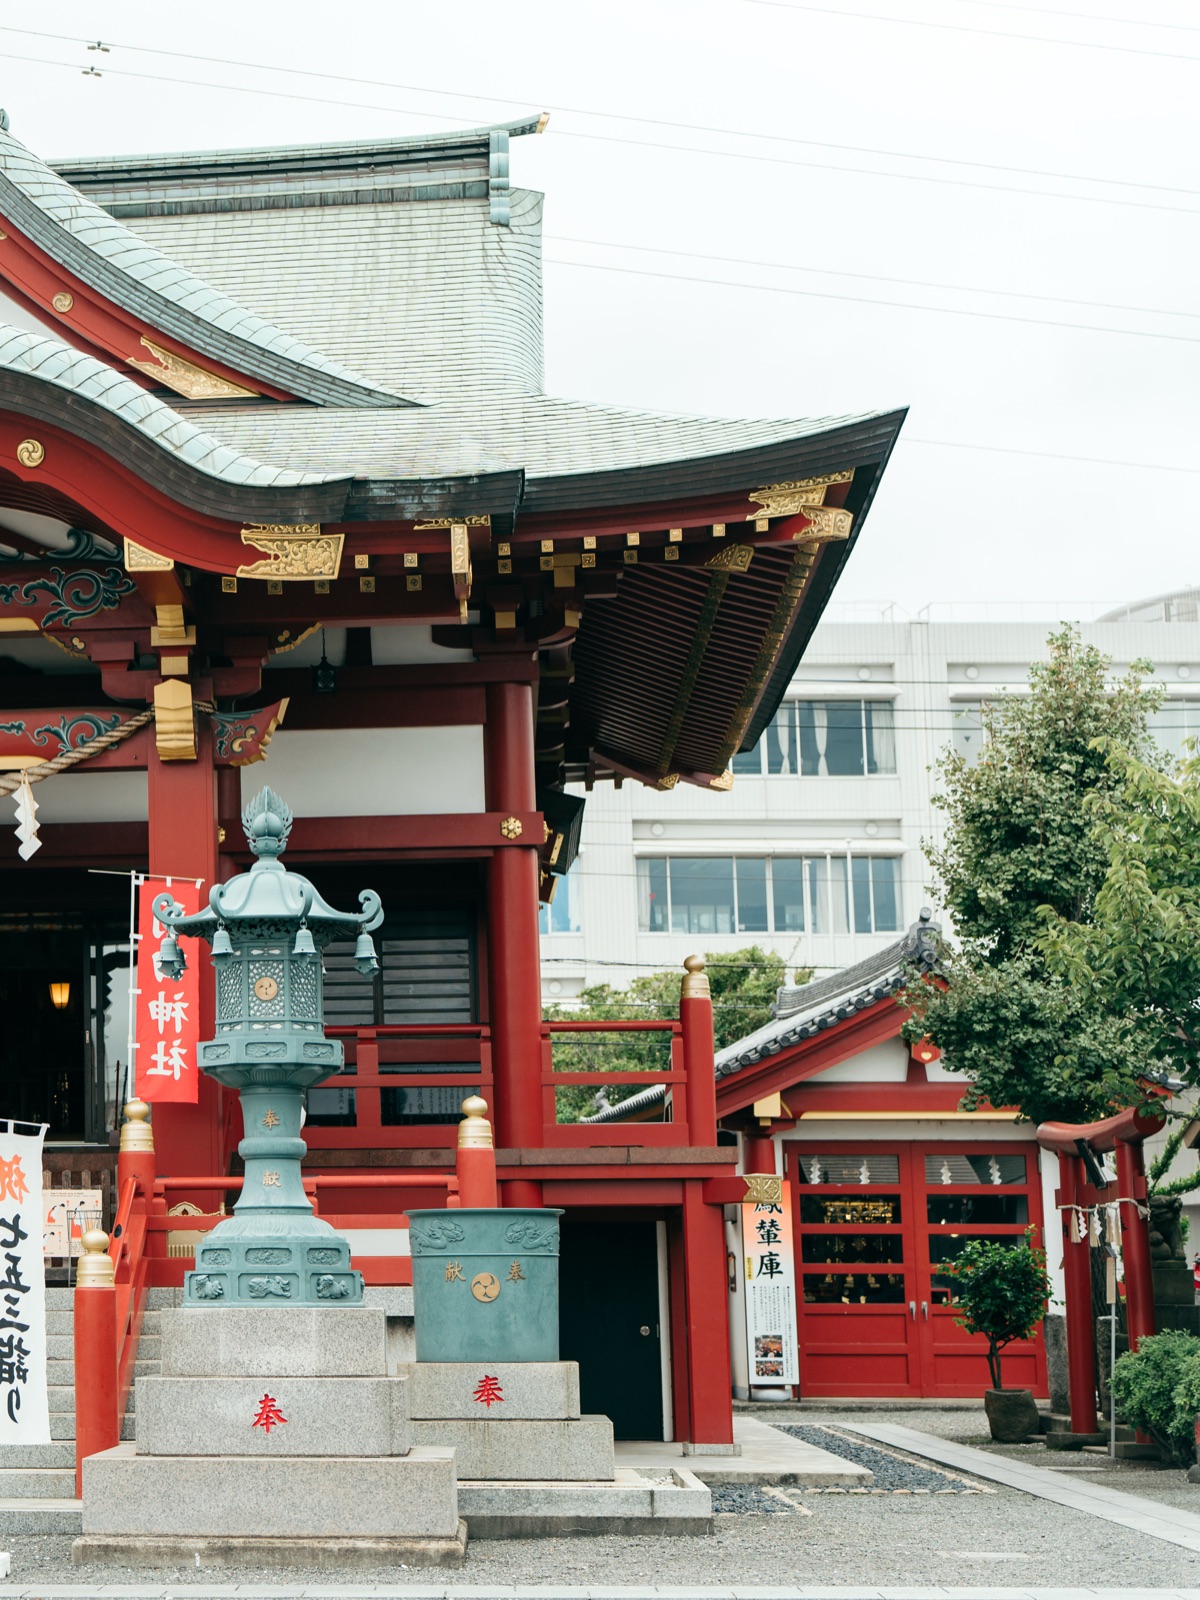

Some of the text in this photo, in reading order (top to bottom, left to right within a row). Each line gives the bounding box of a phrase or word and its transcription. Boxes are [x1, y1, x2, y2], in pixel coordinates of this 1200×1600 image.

[262, 1108, 282, 1187] 奉 献
[444, 1259, 526, 1284] 奉 献
[473, 1374, 505, 1408] 奉
[252, 1393, 288, 1434] 奉
